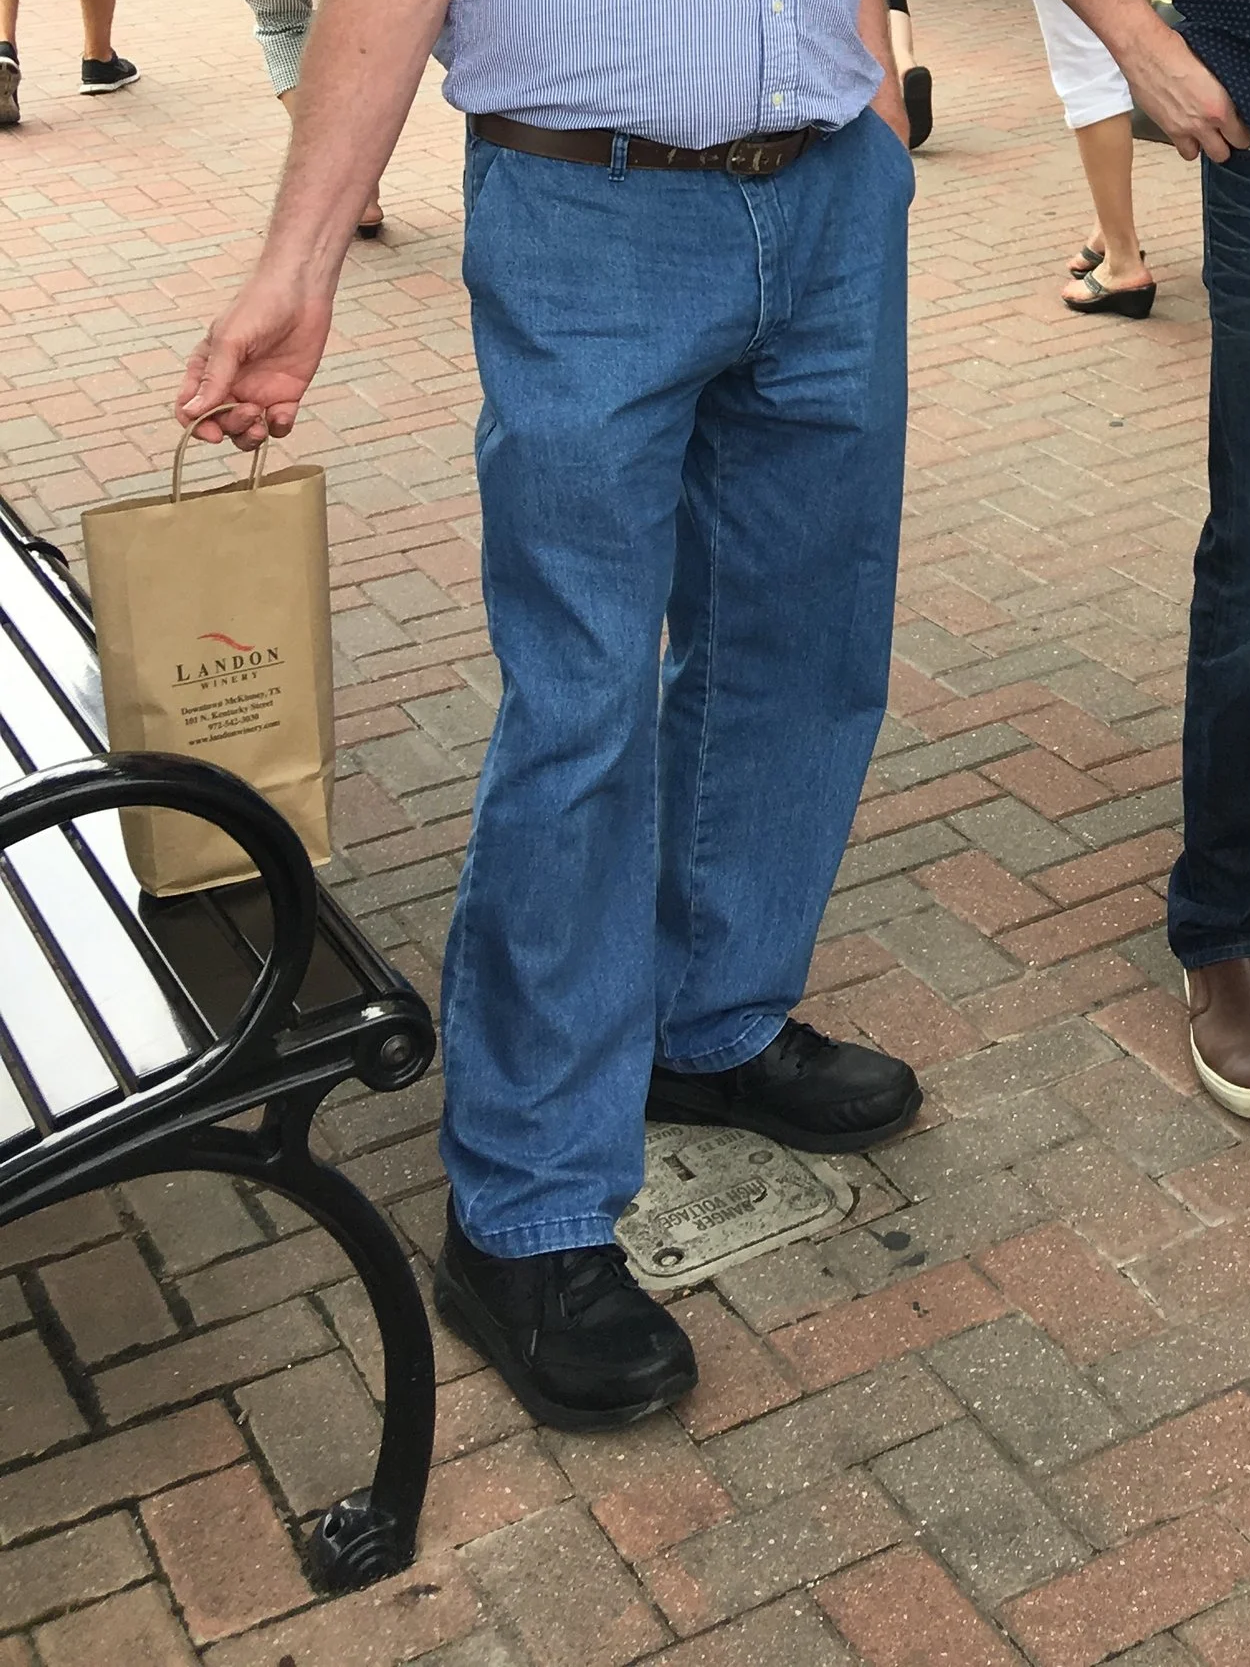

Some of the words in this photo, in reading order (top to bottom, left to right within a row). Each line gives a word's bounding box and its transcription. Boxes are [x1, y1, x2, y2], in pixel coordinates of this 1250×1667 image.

[176, 647, 279, 682] LANDON
[201, 672, 258, 690] WINERY
[181, 701, 223, 716] Downtown
[224, 692, 267, 707] McKinney,
[268, 687, 281, 695] TX
[185, 717, 198, 726] 101
[211, 706, 248, 720] Kentucky
[251, 701, 274, 711] Street
[188, 720, 281, 746] www.landonwinery.com
[725, 1181, 765, 1203] HIGH
[660, 1196, 728, 1229] VOLTAGE
[691, 1200, 756, 1231] DANGER
